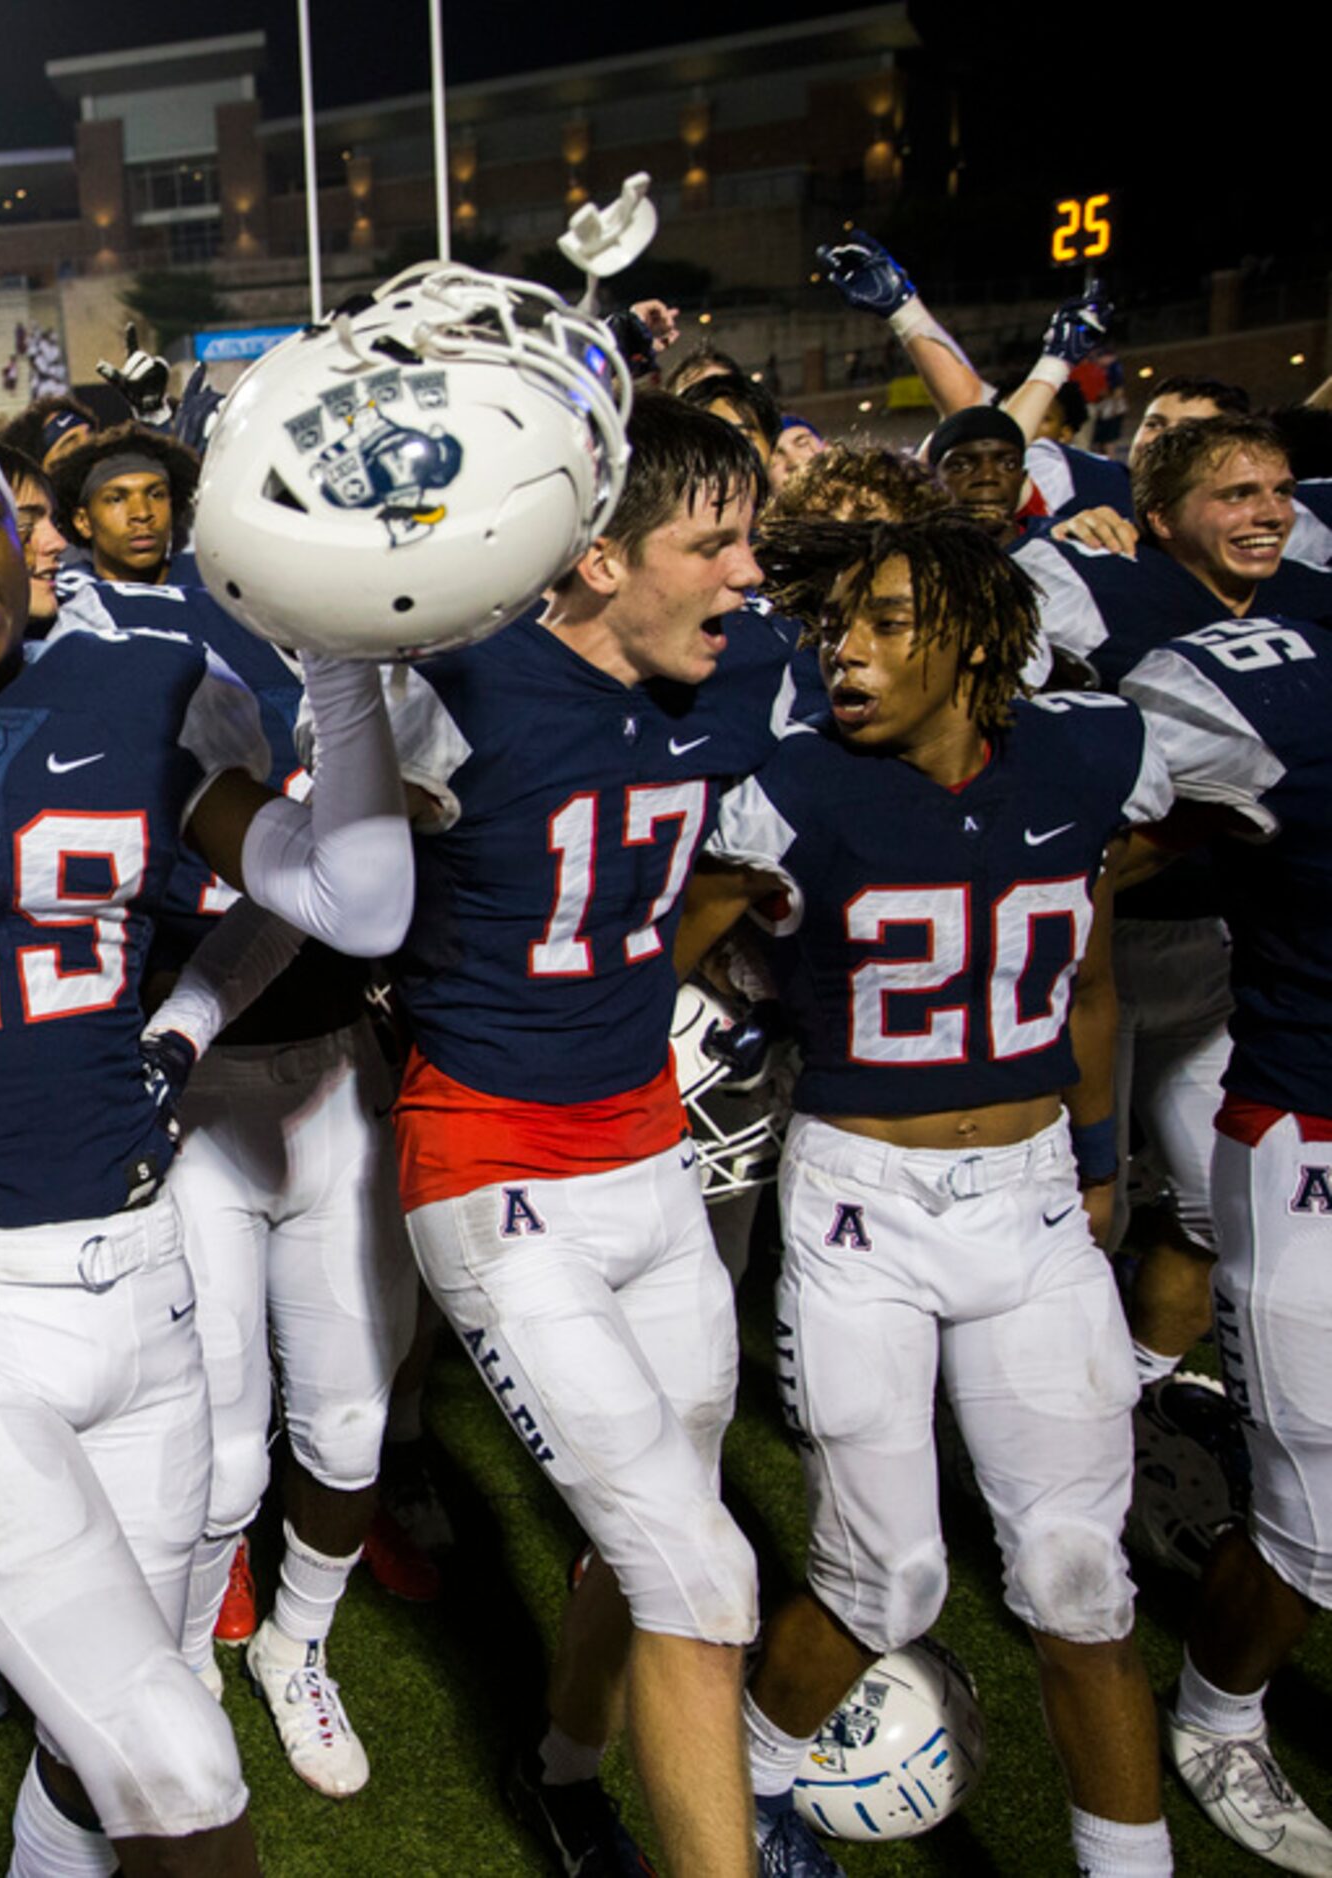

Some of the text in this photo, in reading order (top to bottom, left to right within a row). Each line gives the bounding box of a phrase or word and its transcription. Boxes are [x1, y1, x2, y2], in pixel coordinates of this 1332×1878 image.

[1052, 194, 1110, 261] 25
[527, 776, 709, 978] 17
[844, 870, 1094, 1068] 20
[500, 1186, 546, 1238] A
[1289, 1163, 1332, 1214] A
[824, 1202, 872, 1251] A
